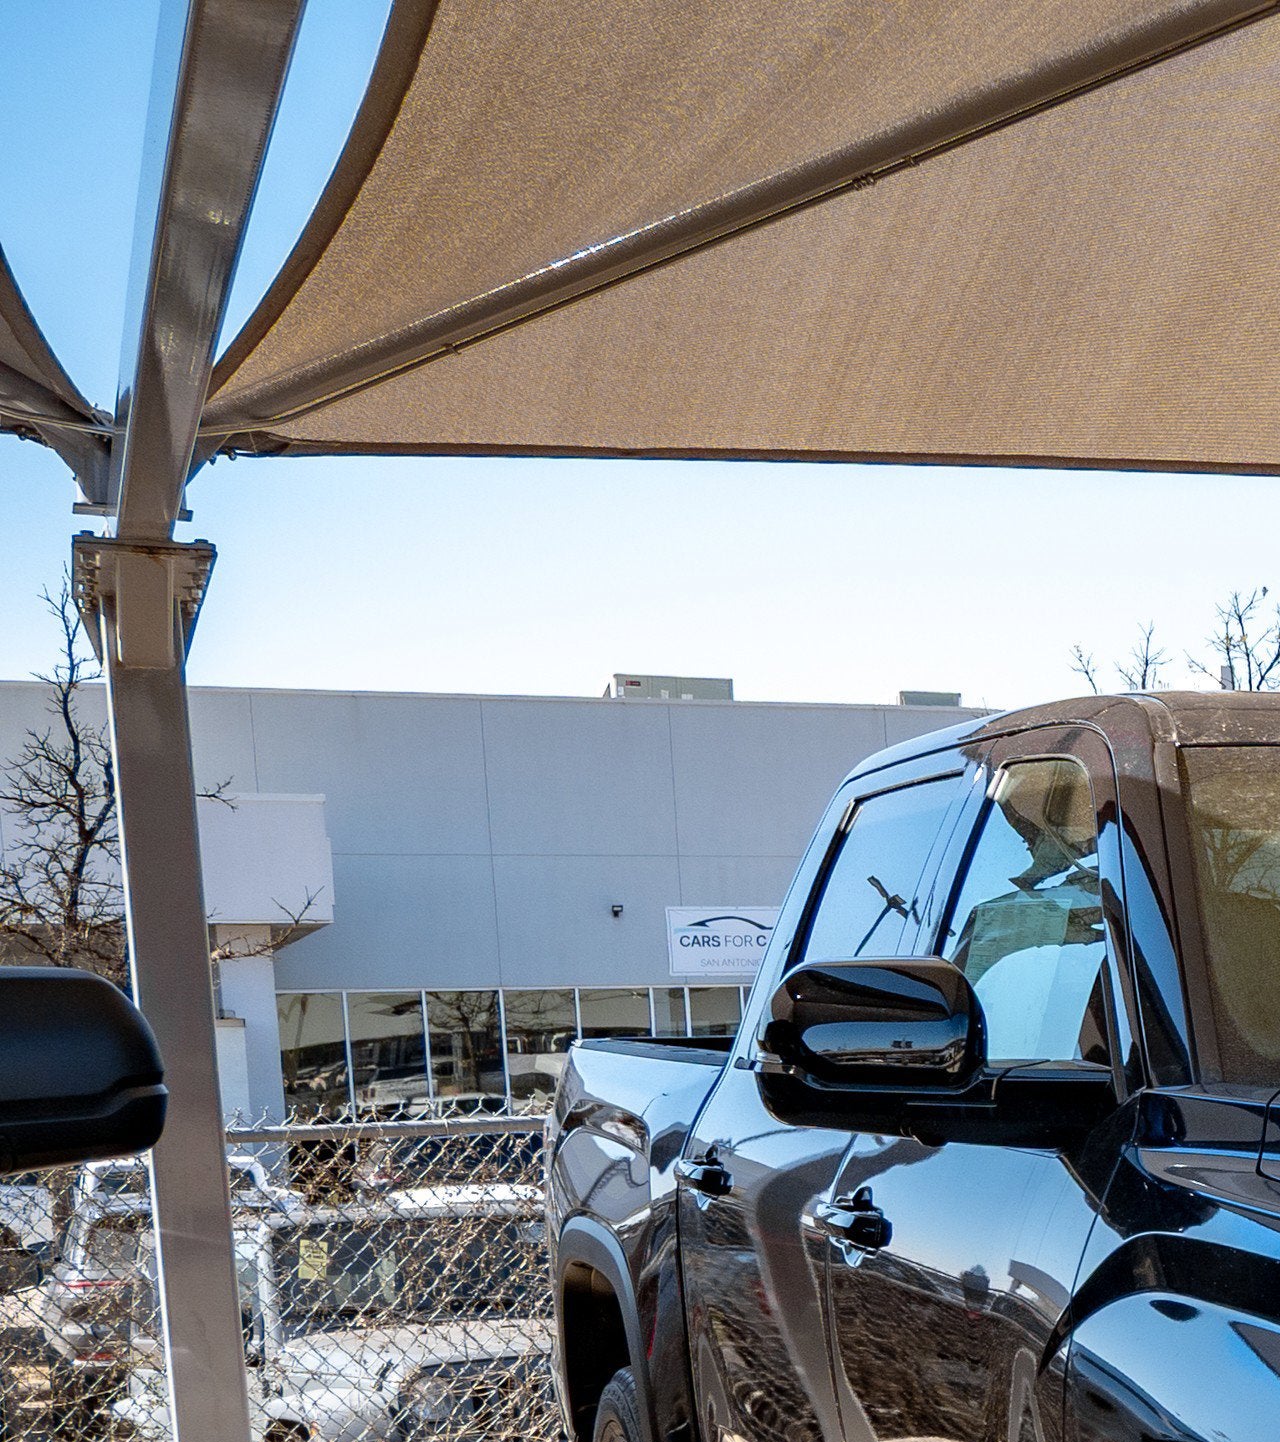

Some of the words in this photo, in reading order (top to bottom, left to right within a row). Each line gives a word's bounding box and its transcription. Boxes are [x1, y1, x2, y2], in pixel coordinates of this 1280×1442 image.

[679, 935, 721, 948] CARS
[724, 935, 754, 948] FOR
[700, 958, 720, 968] SAN
